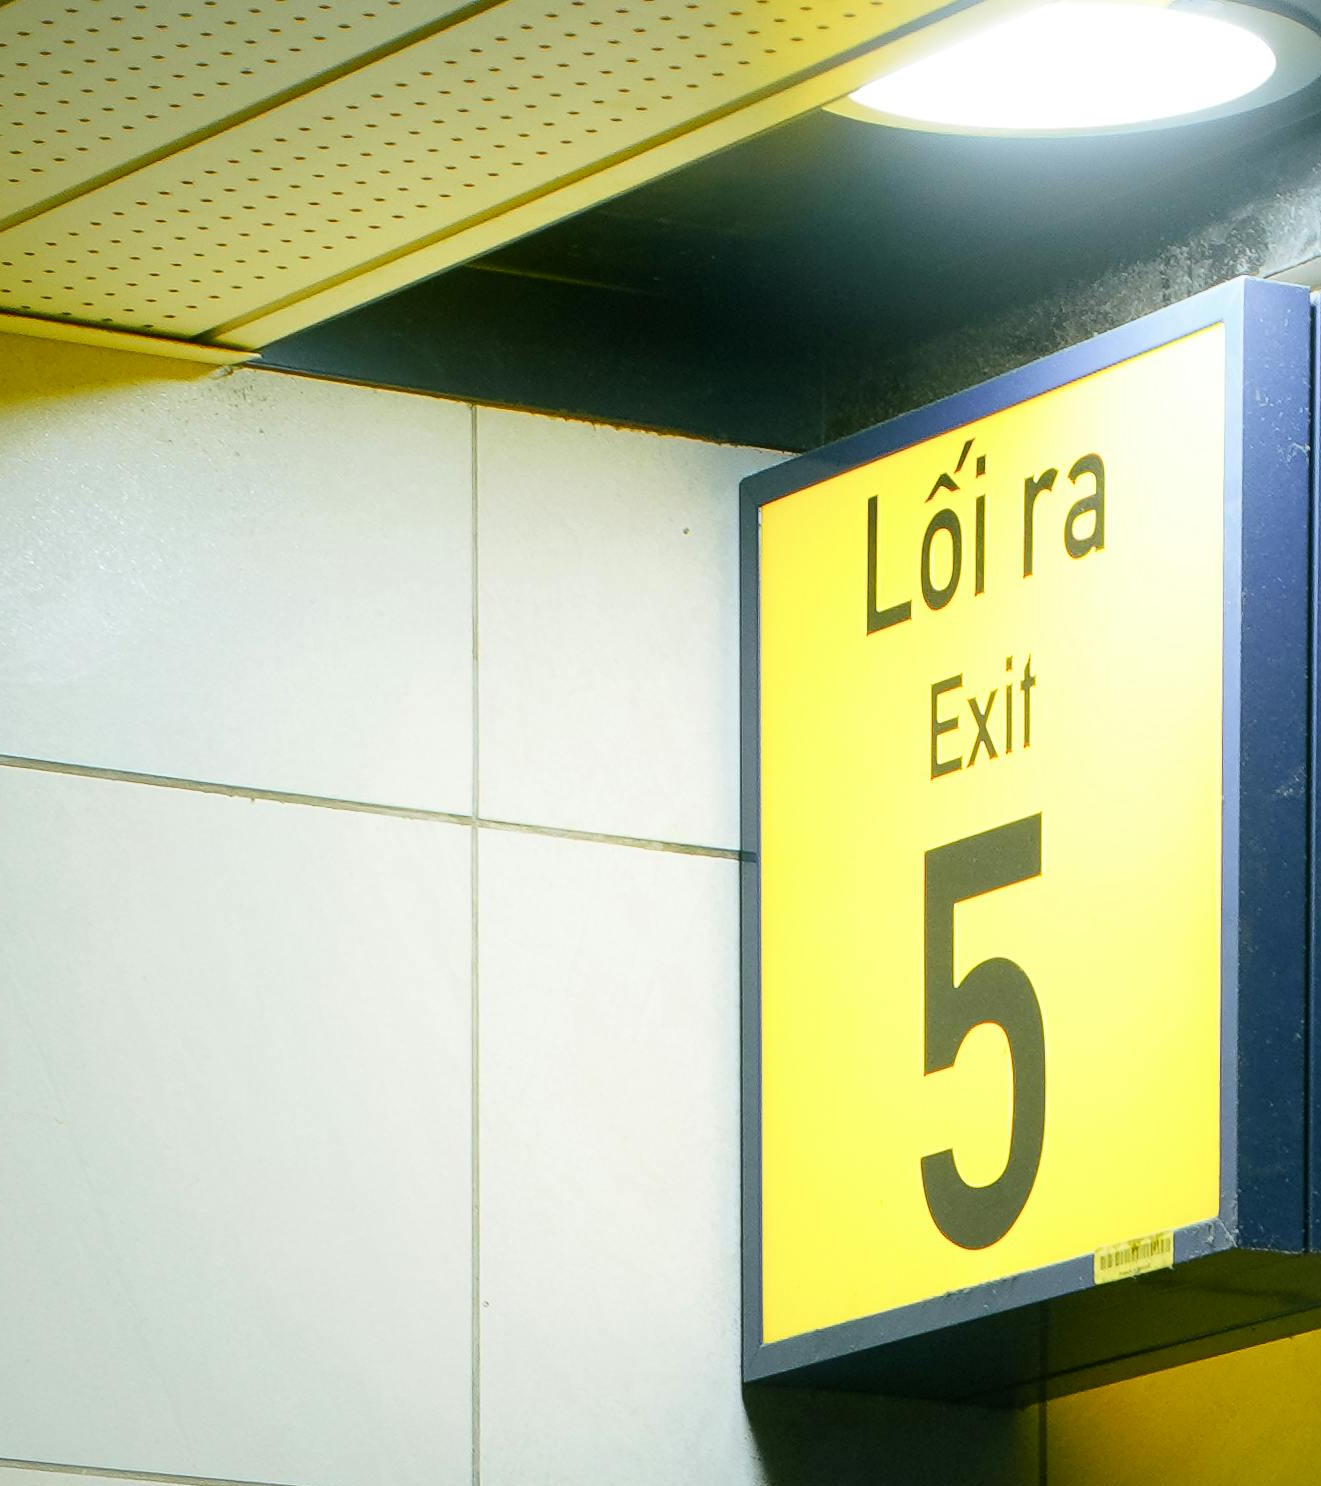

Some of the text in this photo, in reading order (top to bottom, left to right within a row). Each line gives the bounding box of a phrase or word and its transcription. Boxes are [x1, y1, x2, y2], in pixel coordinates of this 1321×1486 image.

[866, 439, 1106, 636] Lối ra
[930, 654, 1038, 781] Exit
[920, 812, 1046, 1251] 5
